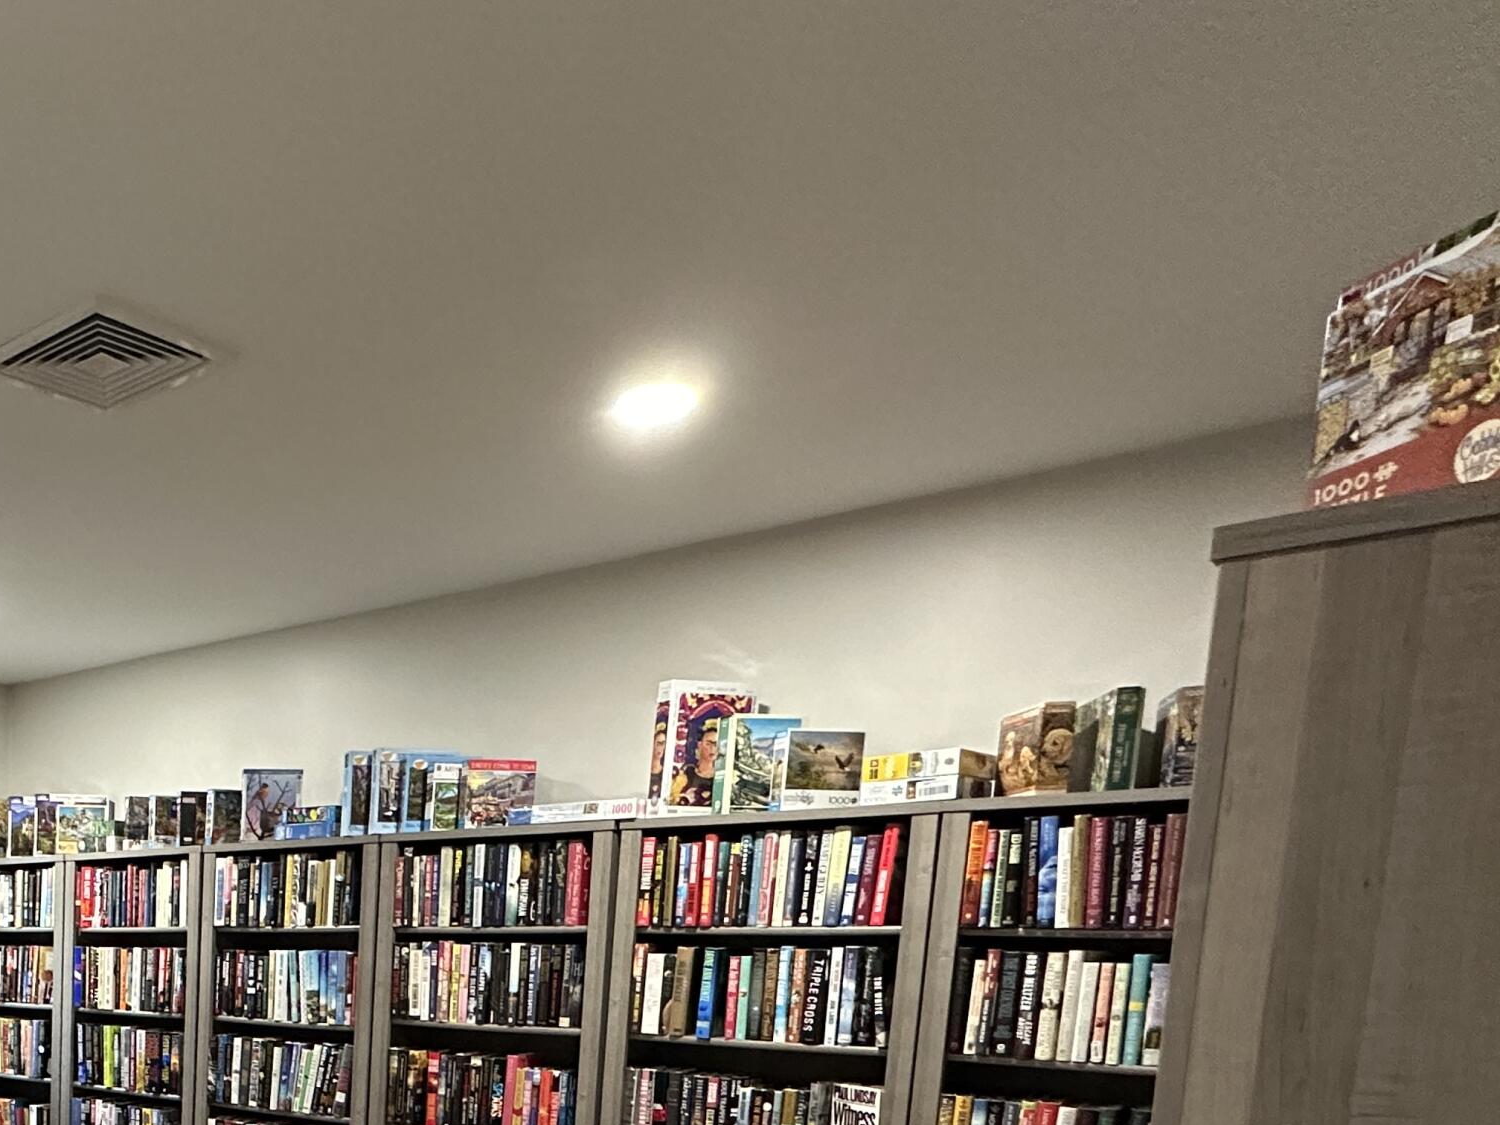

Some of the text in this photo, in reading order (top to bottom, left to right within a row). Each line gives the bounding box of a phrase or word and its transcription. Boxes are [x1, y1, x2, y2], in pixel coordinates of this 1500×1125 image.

[1314, 472, 1370, 506] 1000
[612, 803, 632, 815] 1000
[829, 796, 851, 805] 1000
[1024, 954, 1038, 975] BRAD
[802, 959, 825, 1032] TRIPLE CROSS
[1019, 976, 1036, 1011] MELTZER
[490, 1082, 502, 1117] SPOOKS
